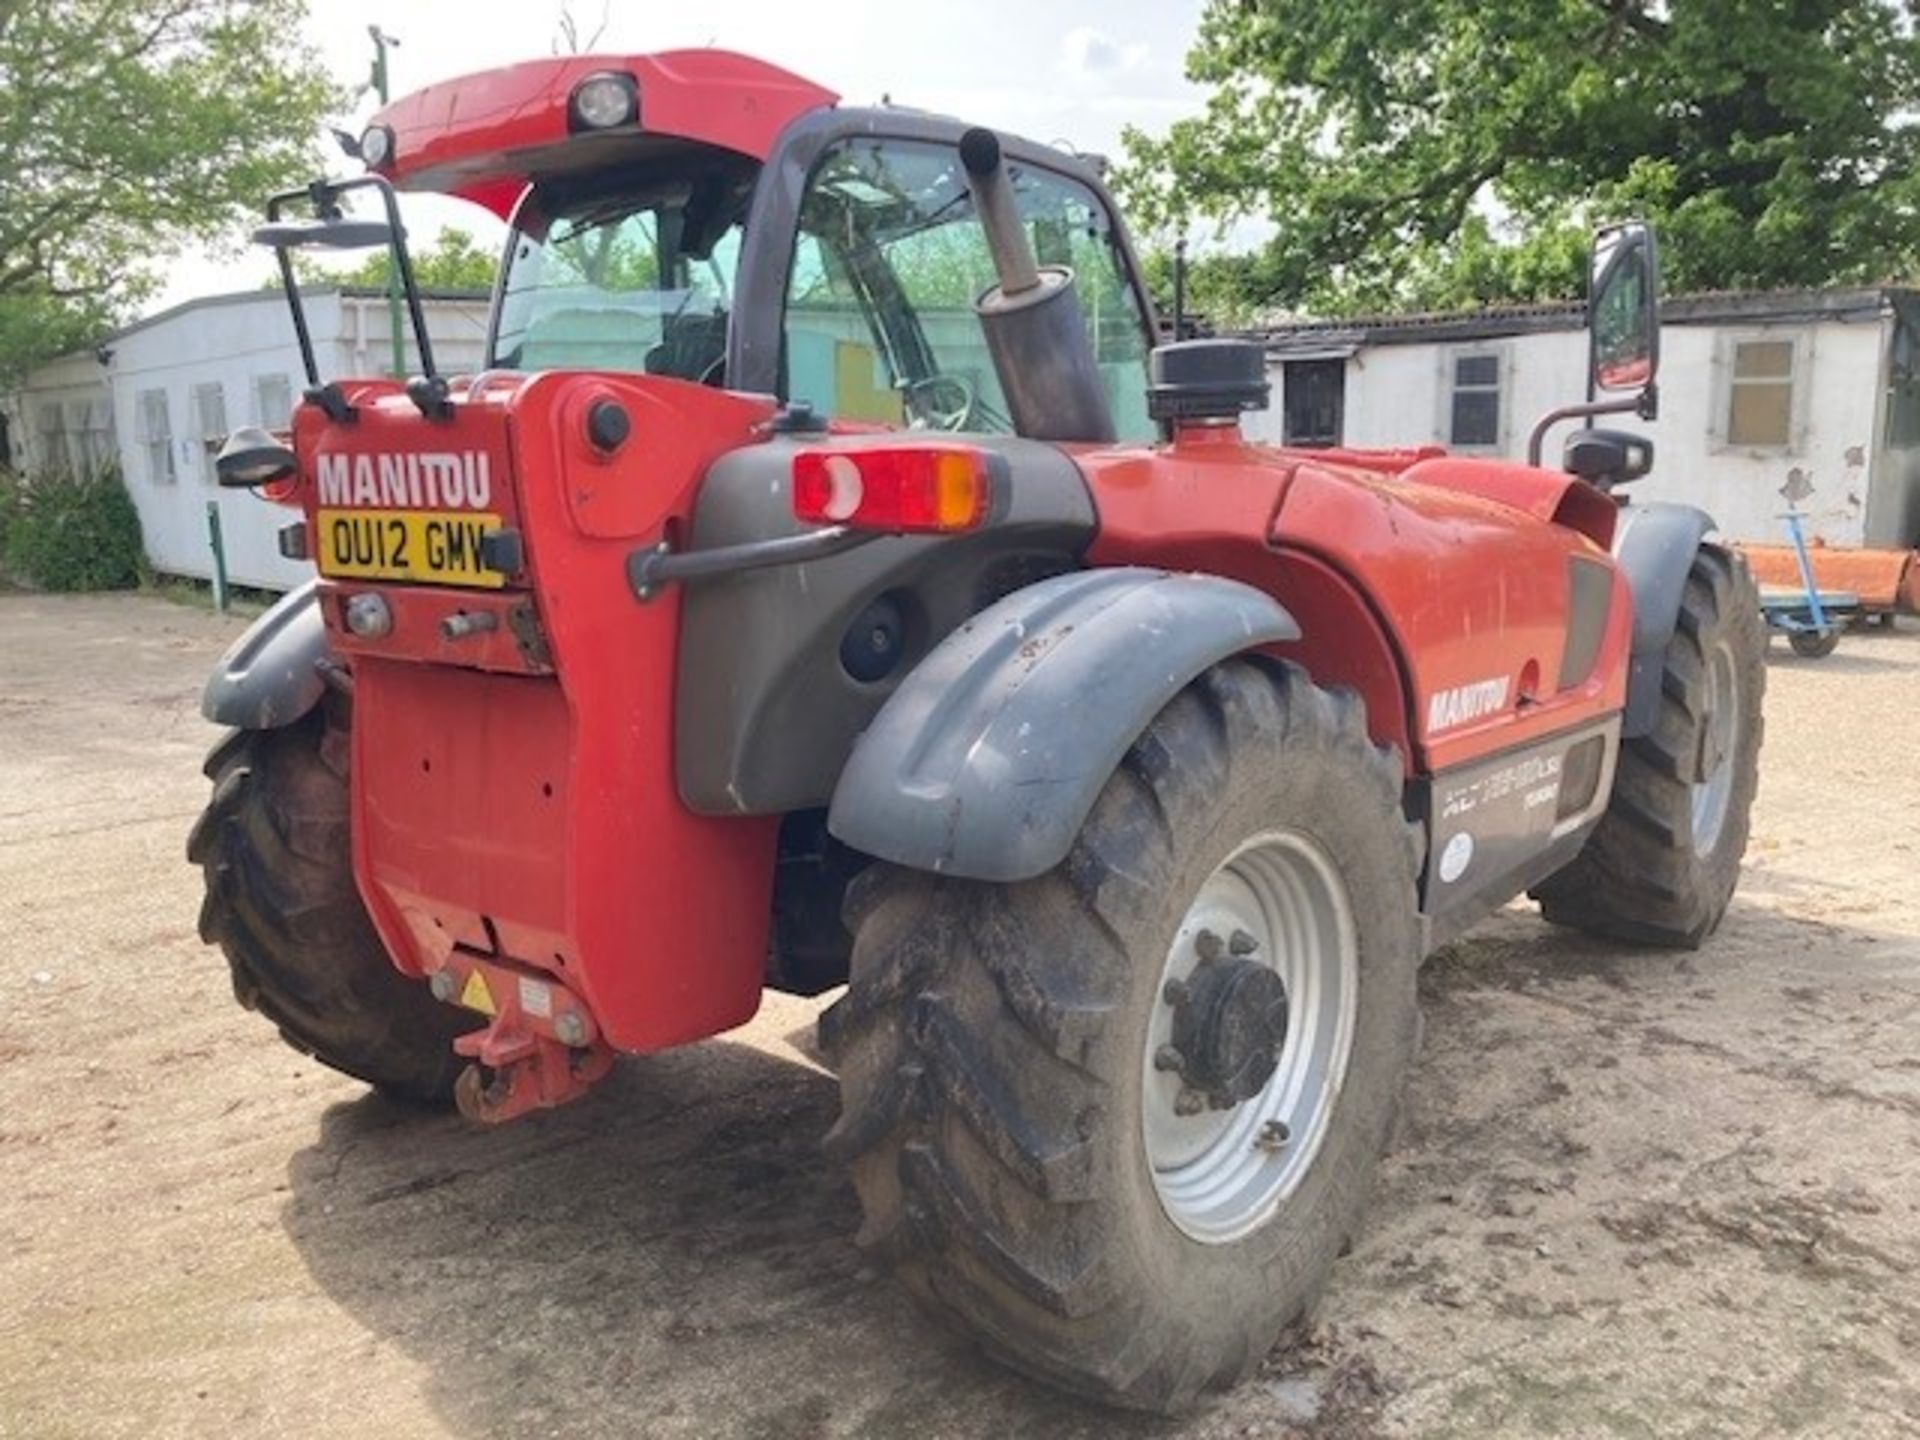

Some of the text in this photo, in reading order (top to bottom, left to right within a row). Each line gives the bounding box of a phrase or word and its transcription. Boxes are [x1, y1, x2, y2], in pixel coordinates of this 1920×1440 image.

[317, 452, 491, 508] MANITOU
[333, 518, 409, 568] OU12
[1427, 674, 1510, 733] MANITOU
